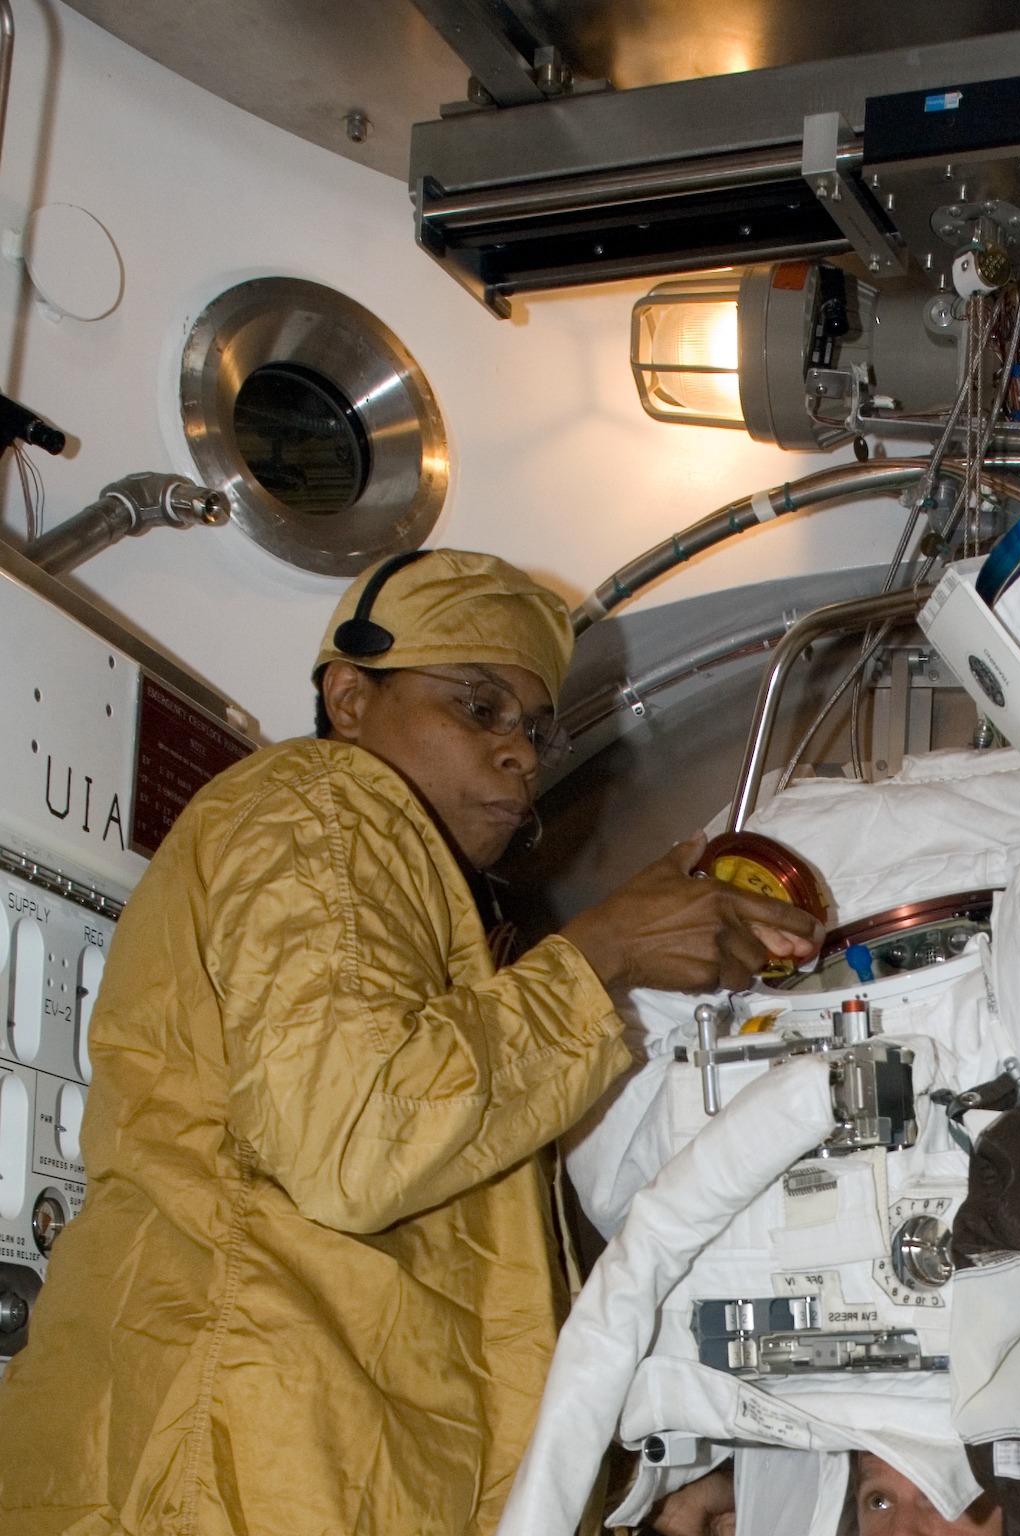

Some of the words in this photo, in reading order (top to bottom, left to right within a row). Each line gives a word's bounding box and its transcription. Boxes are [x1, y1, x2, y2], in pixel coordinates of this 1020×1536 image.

[46, 755, 124, 851] UIA
[8, 892, 50, 924] SUPPLY
[84, 926, 104, 947] REG
[44, 998, 72, 1022] EV-2
[41, 1113, 52, 1123] PWR
[40, 1155, 67, 1169] DEPRESS
[70, 1163, 85, 1173] PUMP
[65, 1182, 84, 1194] ORLAN
[0, 1232, 14, 1243] LAN
[17, 1250, 40, 1261] RELIEF
